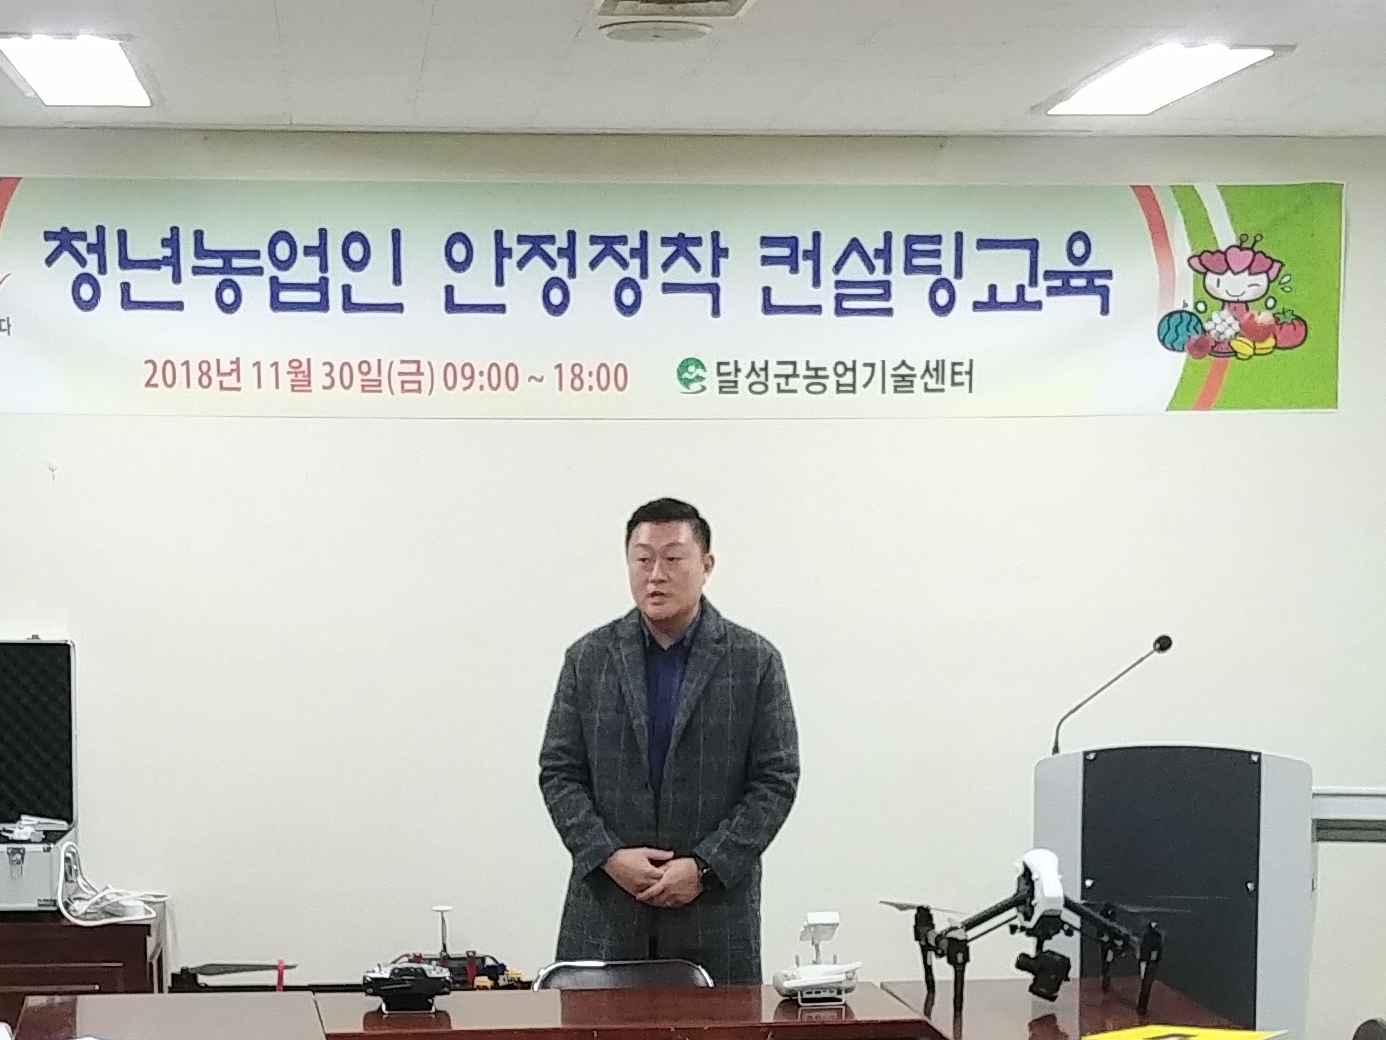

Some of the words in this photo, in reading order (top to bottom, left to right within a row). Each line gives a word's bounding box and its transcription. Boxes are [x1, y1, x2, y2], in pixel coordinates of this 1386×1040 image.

[44, 225, 404, 314] 청년농업인
[444, 229, 729, 318] 안정정착
[760, 230, 1113, 317] 컨설팅교육
[143, 356, 242, 392] 2018년
[251, 357, 313, 394] 11월
[321, 358, 435, 396] 30일(금)
[442, 361, 520, 392] 09:00
[553, 361, 629, 392] 18:00
[715, 358, 974, 396] 달성군농업기술센터
